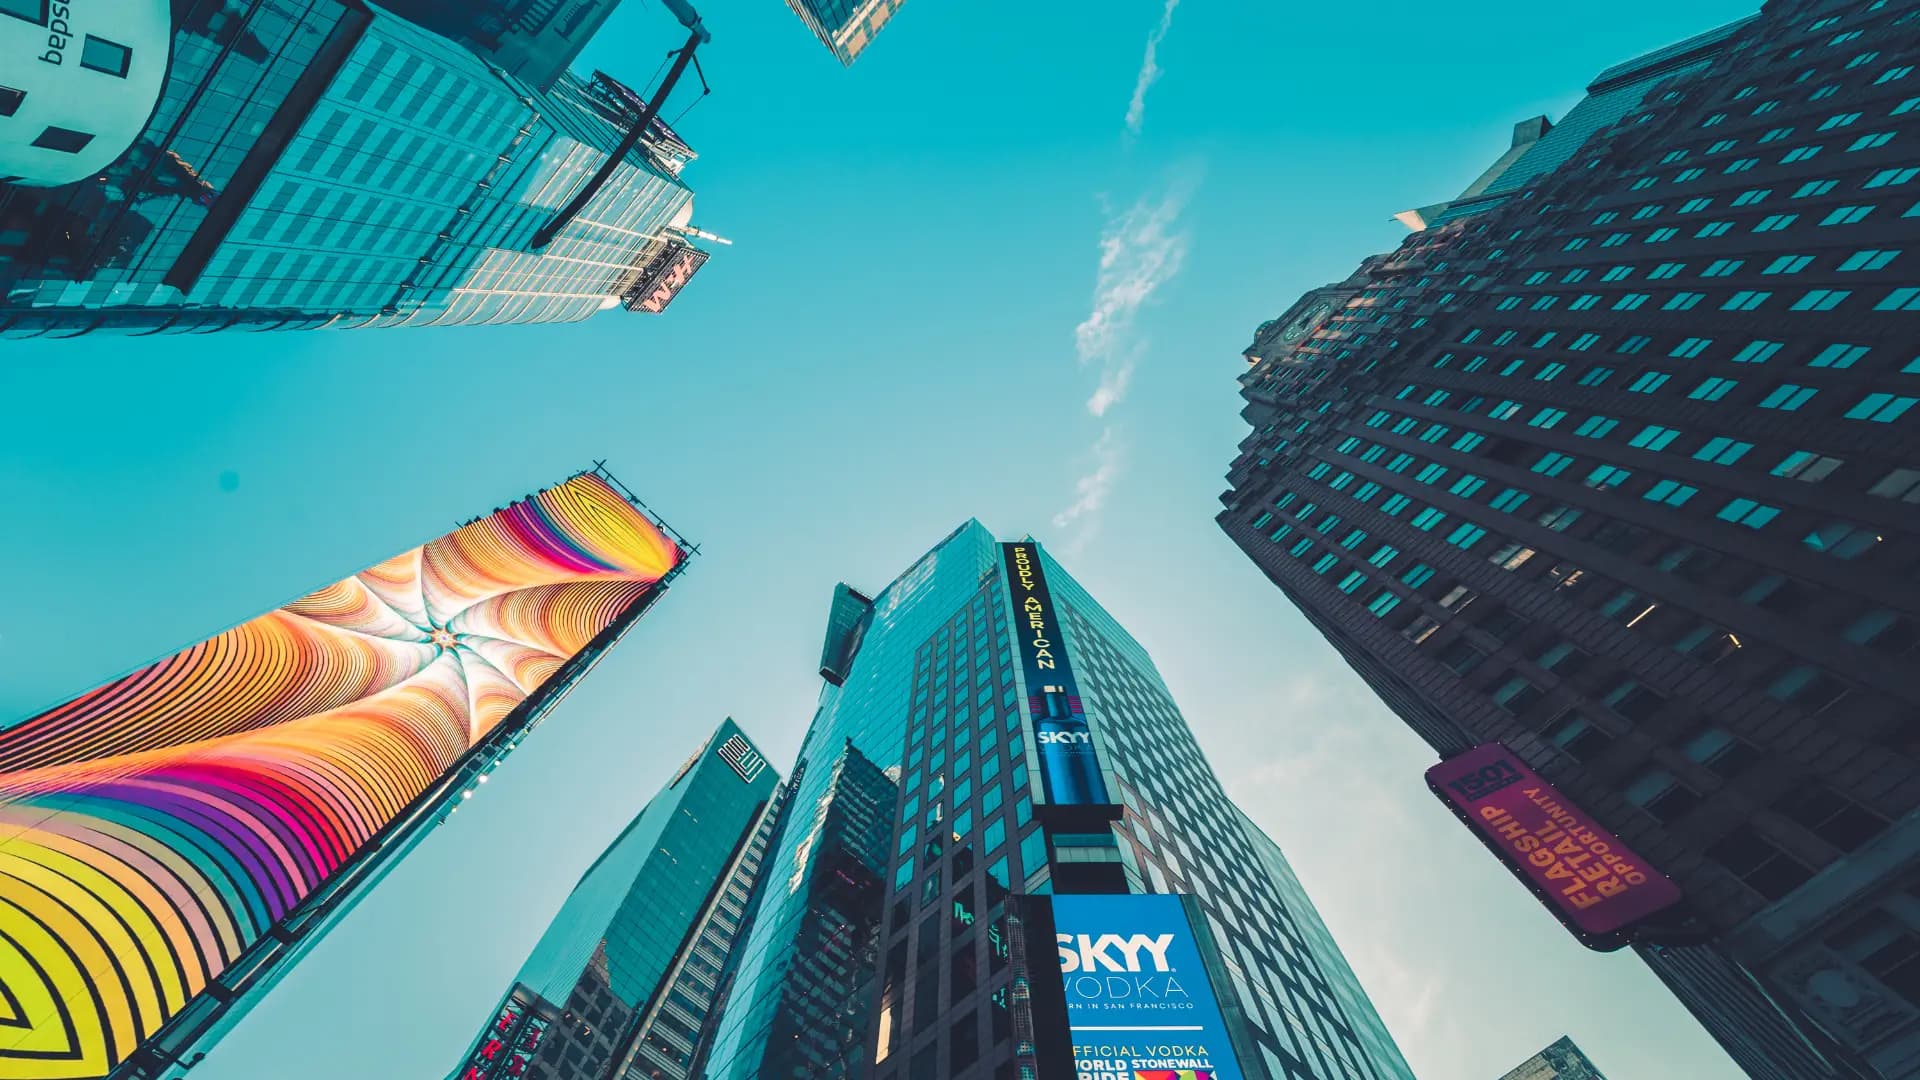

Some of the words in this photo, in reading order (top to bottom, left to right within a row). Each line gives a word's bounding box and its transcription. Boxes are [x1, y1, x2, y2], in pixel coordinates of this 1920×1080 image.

[1014, 546, 1035, 591] PROUDLY
[1024, 596, 1056, 670] AMERICAN
[1037, 731, 1091, 744] SKYY
[1480, 805, 1602, 909] FLAGSHIP
[1522, 787, 1647, 885] OPPORTUNITY
[1535, 820, 1628, 898] RETAIL
[1056, 933, 1175, 973] SKYY
[1131, 1058, 1215, 1069] STONEWALL
[1145, 1045, 1209, 1057] VODKA
